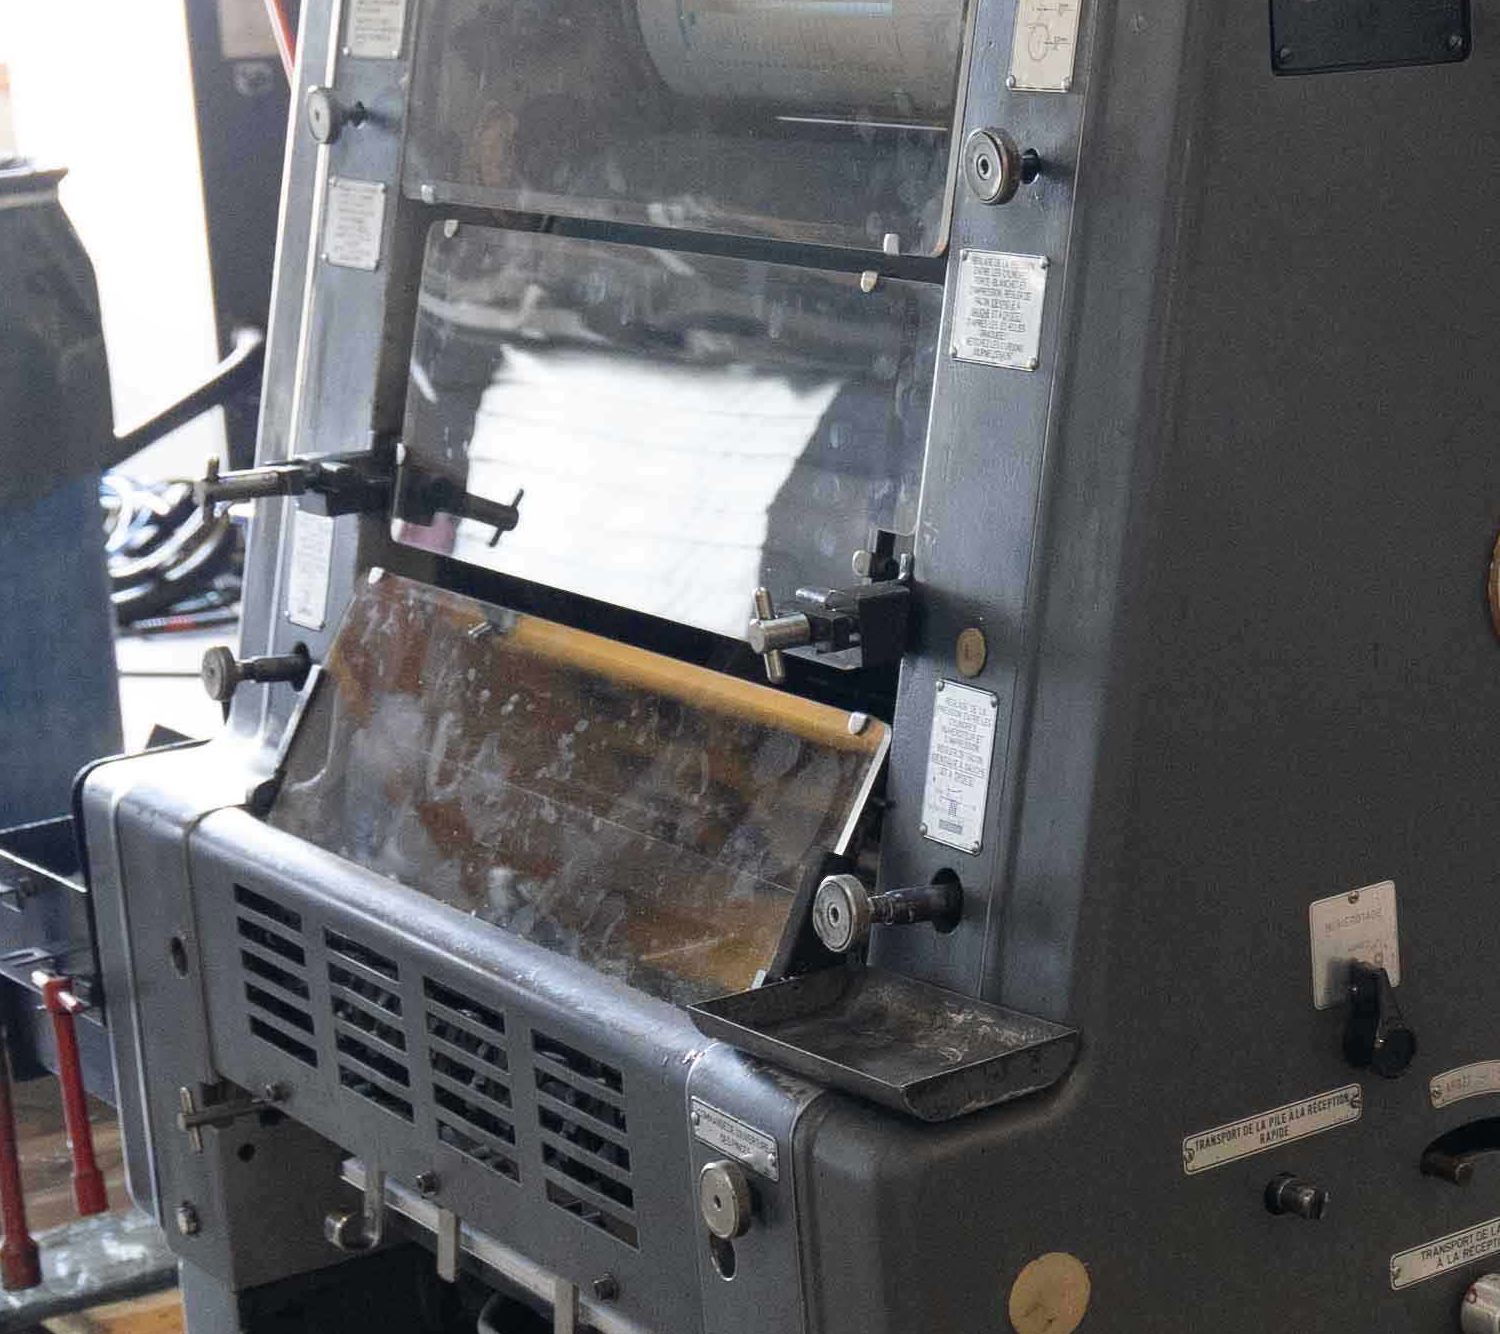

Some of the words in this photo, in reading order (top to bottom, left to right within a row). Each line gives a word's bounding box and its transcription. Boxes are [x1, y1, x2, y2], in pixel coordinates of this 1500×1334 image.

[1195, 1127, 1241, 1151] TRANSPORT
[1242, 1122, 1254, 1136] DE
[1255, 1119, 1266, 1132] LA
[1268, 1113, 1287, 1129] PILE
[1295, 1106, 1306, 1120] LA
[1259, 1126, 1289, 1145] RAPIDE
[1420, 1233, 1474, 1261] TRANSPORT
[1476, 1228, 1489, 1242] DE
[1447, 1251, 1460, 1265] LA
